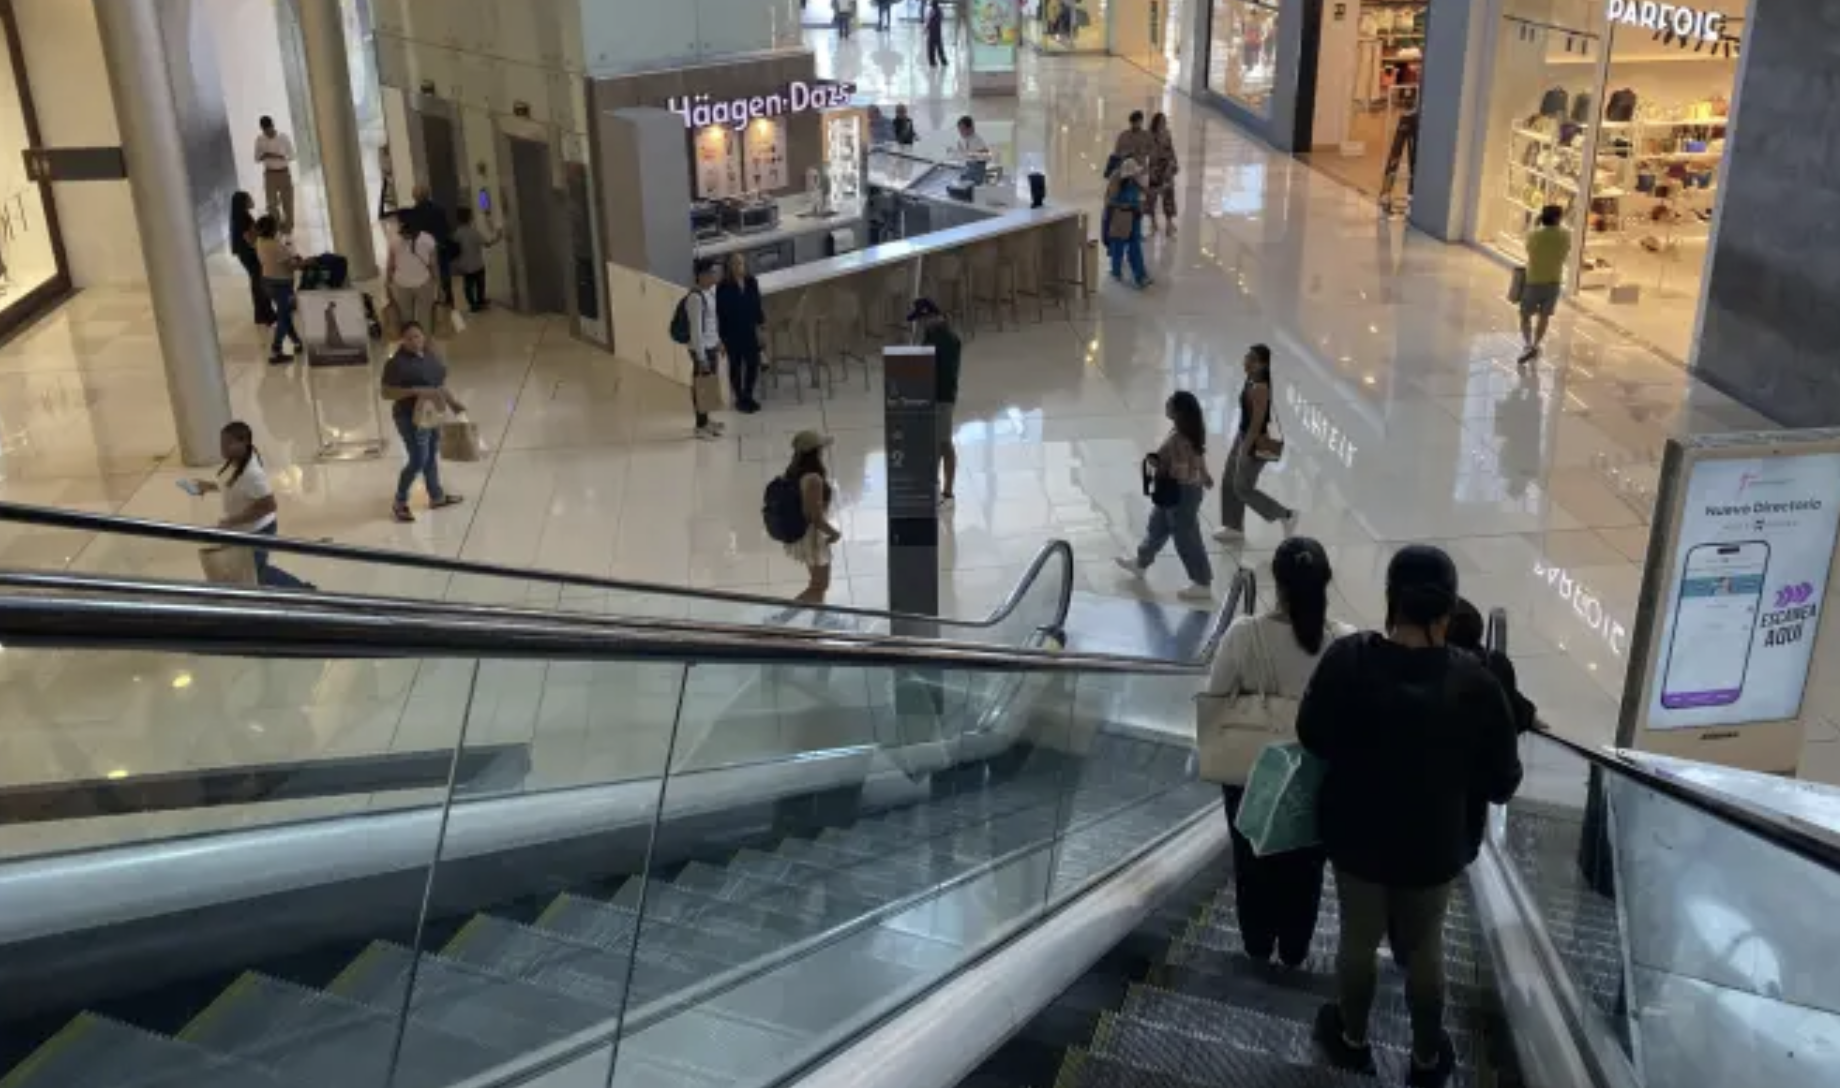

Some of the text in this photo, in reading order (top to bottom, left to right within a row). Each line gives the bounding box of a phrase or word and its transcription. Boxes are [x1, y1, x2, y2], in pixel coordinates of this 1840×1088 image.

[1705, 500, 1822, 516] Nuevo Directorio
[1761, 603, 1816, 628] ESCANEA
